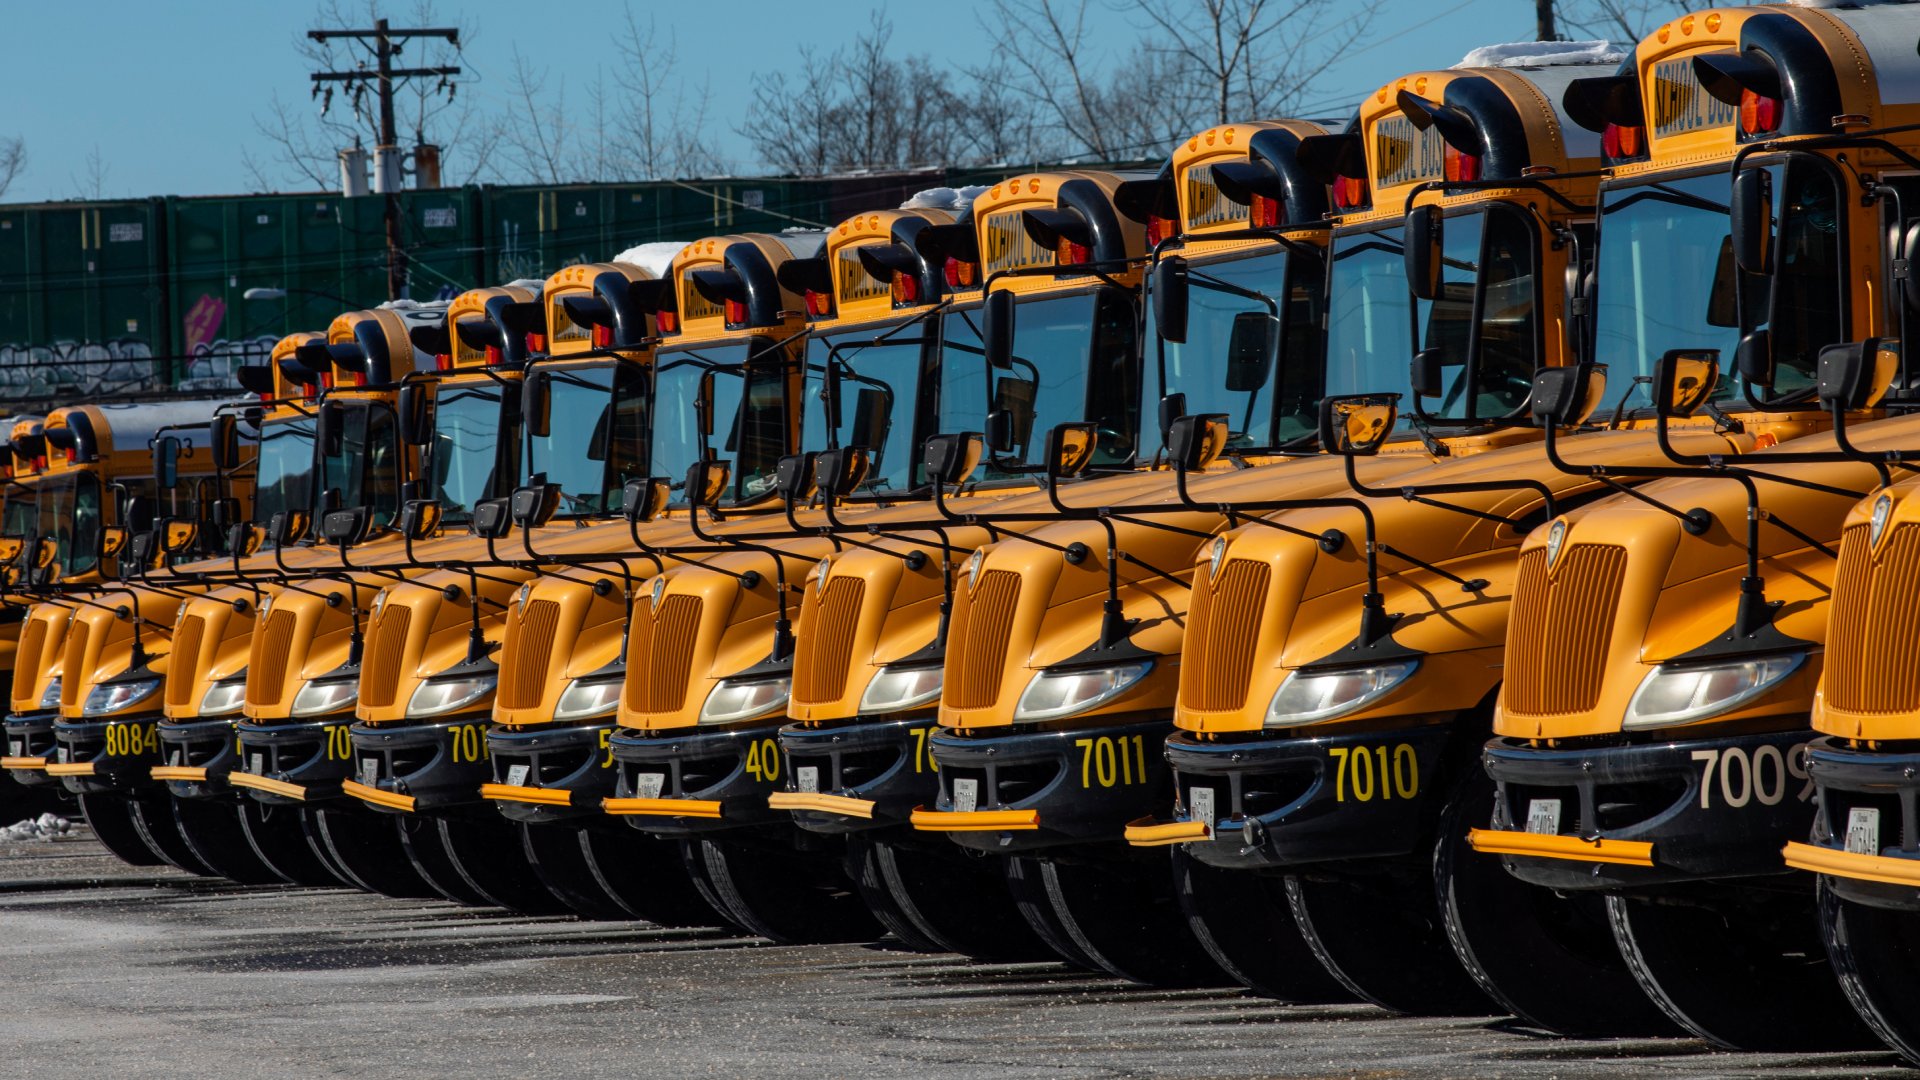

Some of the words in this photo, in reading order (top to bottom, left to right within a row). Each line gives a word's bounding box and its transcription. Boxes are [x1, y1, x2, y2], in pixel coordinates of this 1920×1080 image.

[105, 723, 158, 757] 8084
[323, 725, 352, 761] 70
[447, 724, 489, 763] 701
[599, 727, 621, 769] 5
[745, 738, 780, 782] 40
[1075, 734, 1147, 788] 7011
[1328, 743, 1419, 802] 7010
